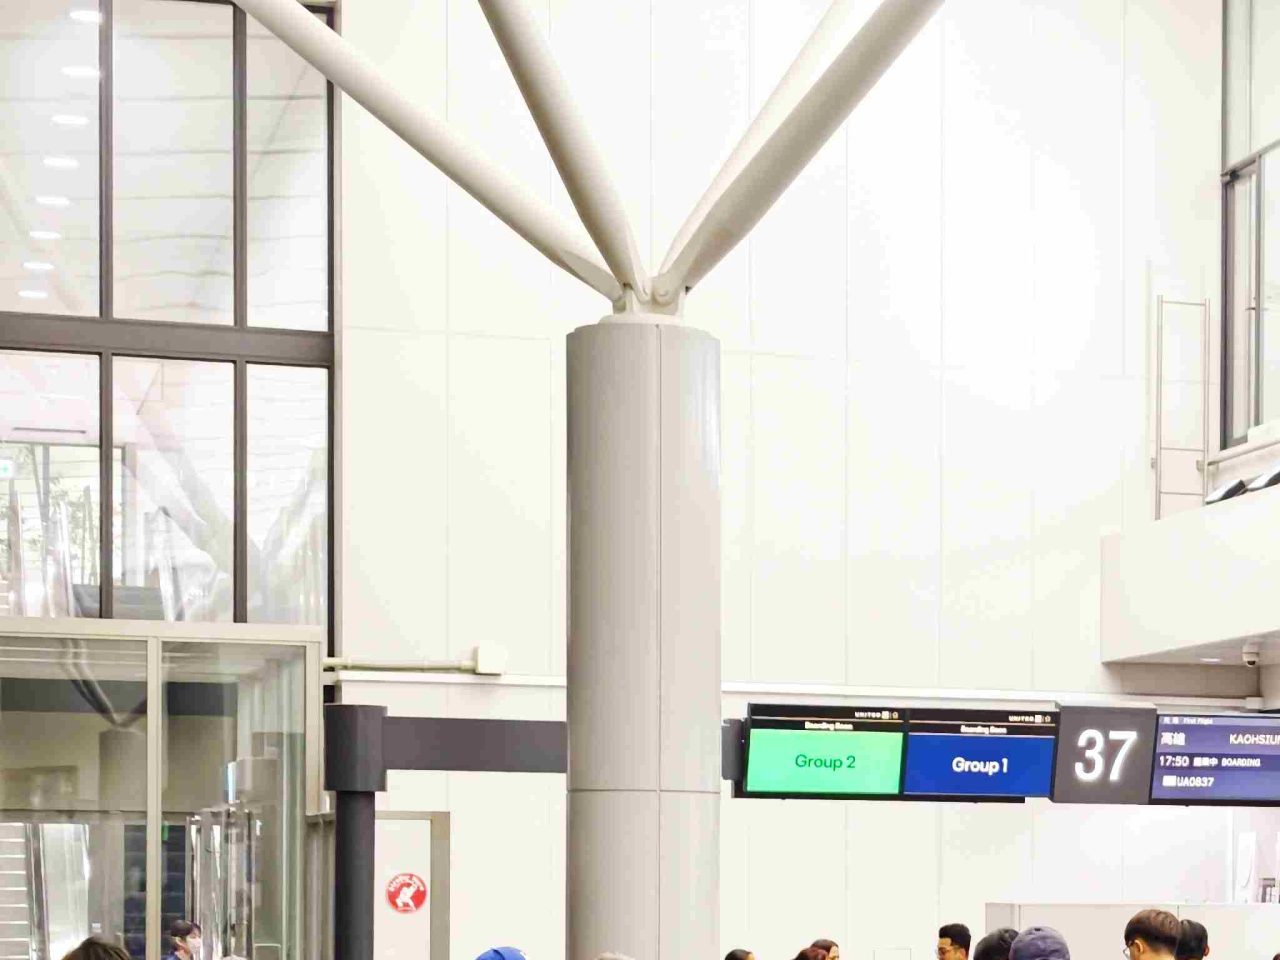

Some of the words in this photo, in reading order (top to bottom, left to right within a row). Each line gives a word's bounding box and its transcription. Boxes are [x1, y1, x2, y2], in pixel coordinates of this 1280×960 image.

[795, 753, 843, 772] Group
[846, 755, 856, 769] 2
[1073, 728, 1138, 783] 37
[1159, 755, 1190, 767] 17:50
[1221, 757, 1261, 768] BOARDING
[951, 756, 1000, 776] Group
[1001, 757, 1009, 774] 1
[1177, 776, 1215, 788] UA0837
